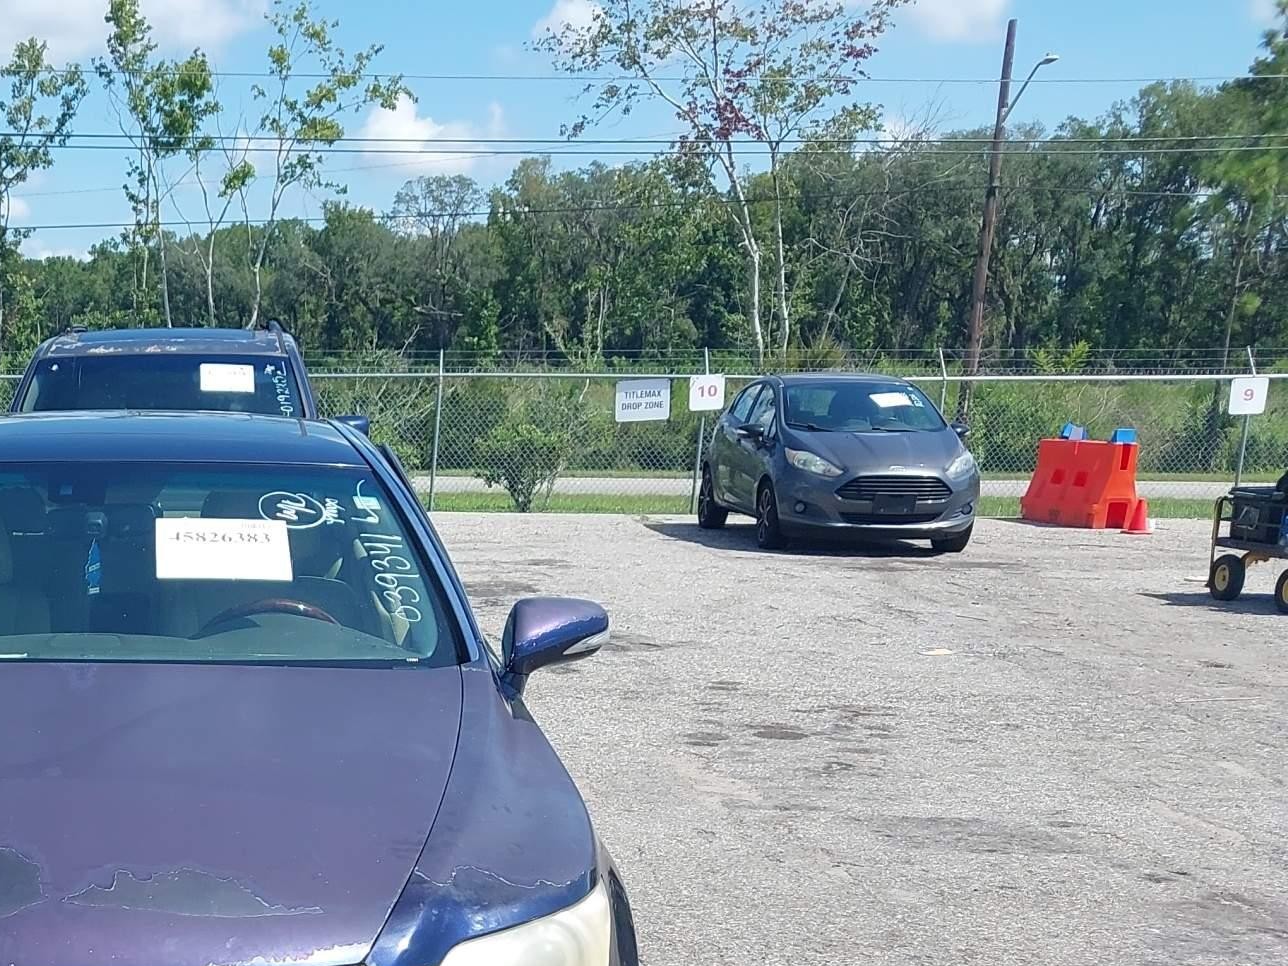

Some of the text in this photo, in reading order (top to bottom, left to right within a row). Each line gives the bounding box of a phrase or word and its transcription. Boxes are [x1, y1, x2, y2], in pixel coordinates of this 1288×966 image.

[624, 390, 662, 399] TITLEMAX
[697, 385, 717, 398] 10
[1244, 389, 1254, 401] 9
[622, 401, 664, 410] DROP ZONE
